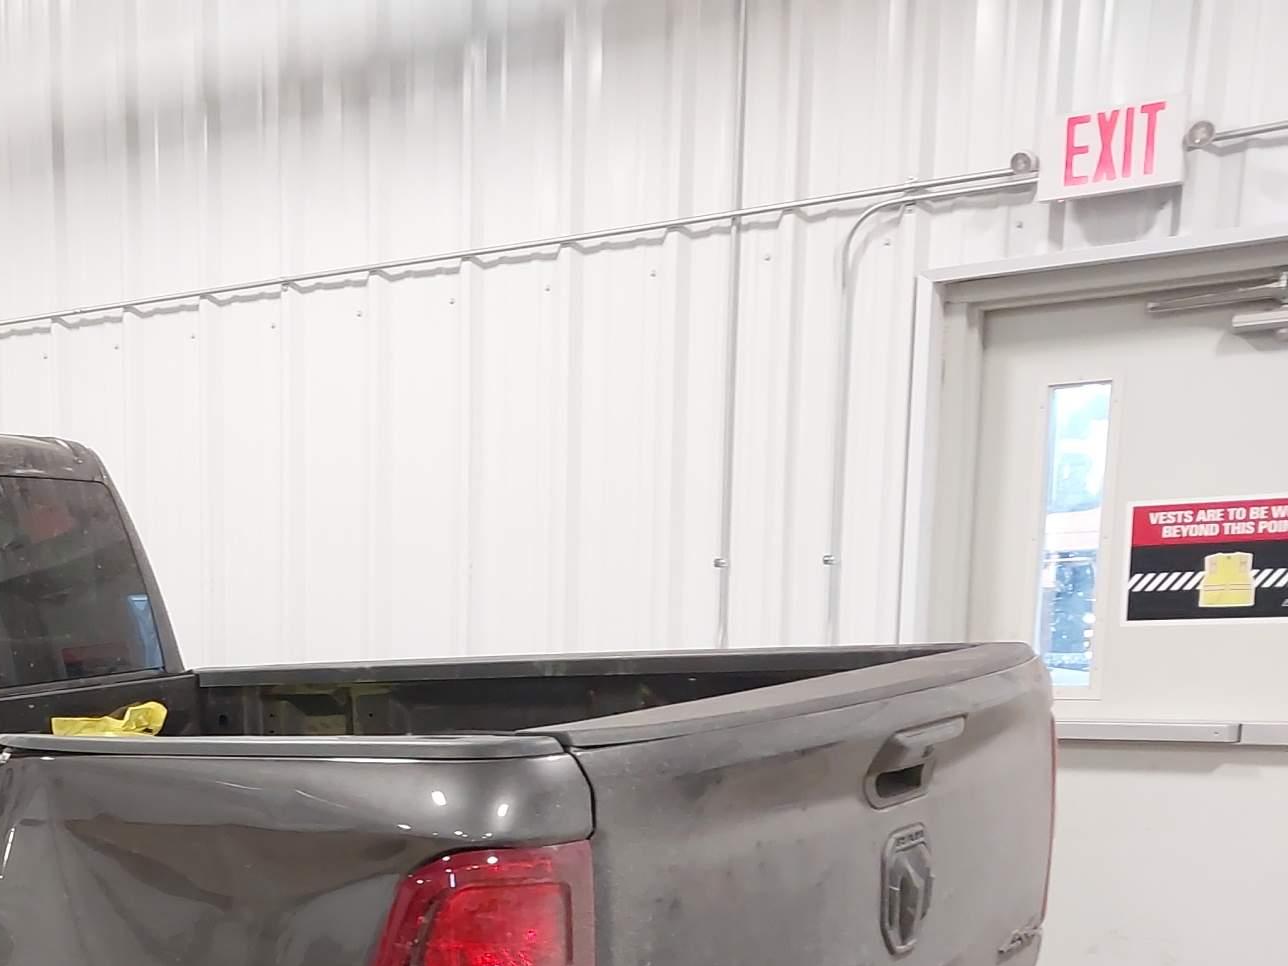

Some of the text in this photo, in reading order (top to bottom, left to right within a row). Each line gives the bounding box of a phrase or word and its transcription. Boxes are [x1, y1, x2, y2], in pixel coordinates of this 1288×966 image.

[1064, 101, 1167, 187] EXIT
[1149, 510, 1194, 525] VESTS
[1196, 508, 1225, 522] ARE
[1227, 507, 1246, 520] TO
[1249, 506, 1269, 519] BE
[1161, 523, 1220, 538] BEYOND
[1222, 521, 1255, 535] THIS
